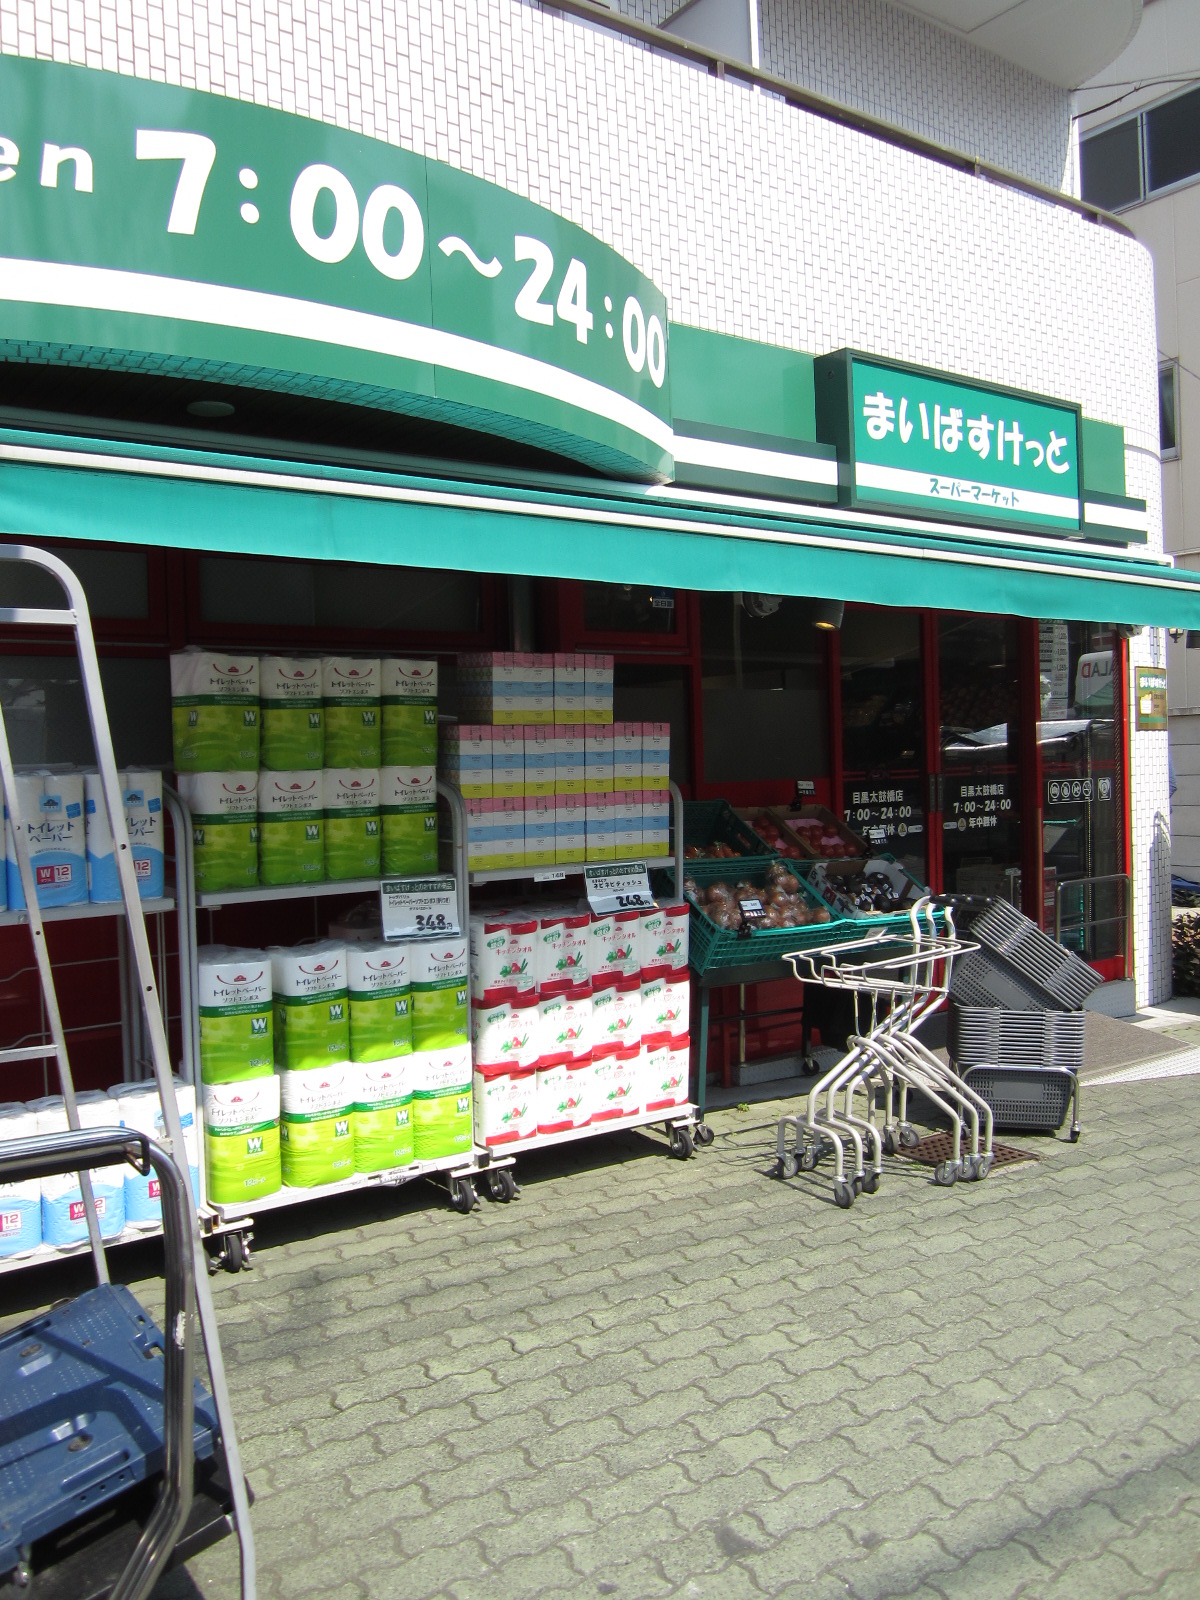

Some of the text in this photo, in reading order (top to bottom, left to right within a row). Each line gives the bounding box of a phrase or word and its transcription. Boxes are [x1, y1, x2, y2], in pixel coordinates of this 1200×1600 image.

[862, 391, 1071, 475] まいばすけっと
[929, 477, 1020, 507] スーパーマーケット
[960, 783, 1005, 798] 目黒太鼓橋店
[852, 789, 904, 805] 目黒太鼓橋店
[27, 821, 75, 834] トイレット
[968, 815, 998, 829] 年中無休
[29, 832, 73, 843] ペーパー
[55, 866, 70, 877] 12
[136, 861, 149, 871] 12
[40, 868, 51, 879] W
[428, 962, 467, 973] トイレットペーパー
[296, 972, 342, 987] トイレットペーパー
[363, 970, 407, 982] トイレットペーパー
[213, 986, 267, 997] トイレットペーパー
[329, 1004, 343, 1016] W
[395, 999, 408, 1011] W
[251, 1017, 267, 1029] W
[457, 1097, 470, 1109] W
[211, 1105, 262, 1117] トイレットペーパー
[396, 1109, 409, 1121] W
[335, 1120, 348, 1133] W
[247, 1136, 263, 1149] W
[73, 1203, 85, 1214] W
[3, 1213, 19, 1224] 12
